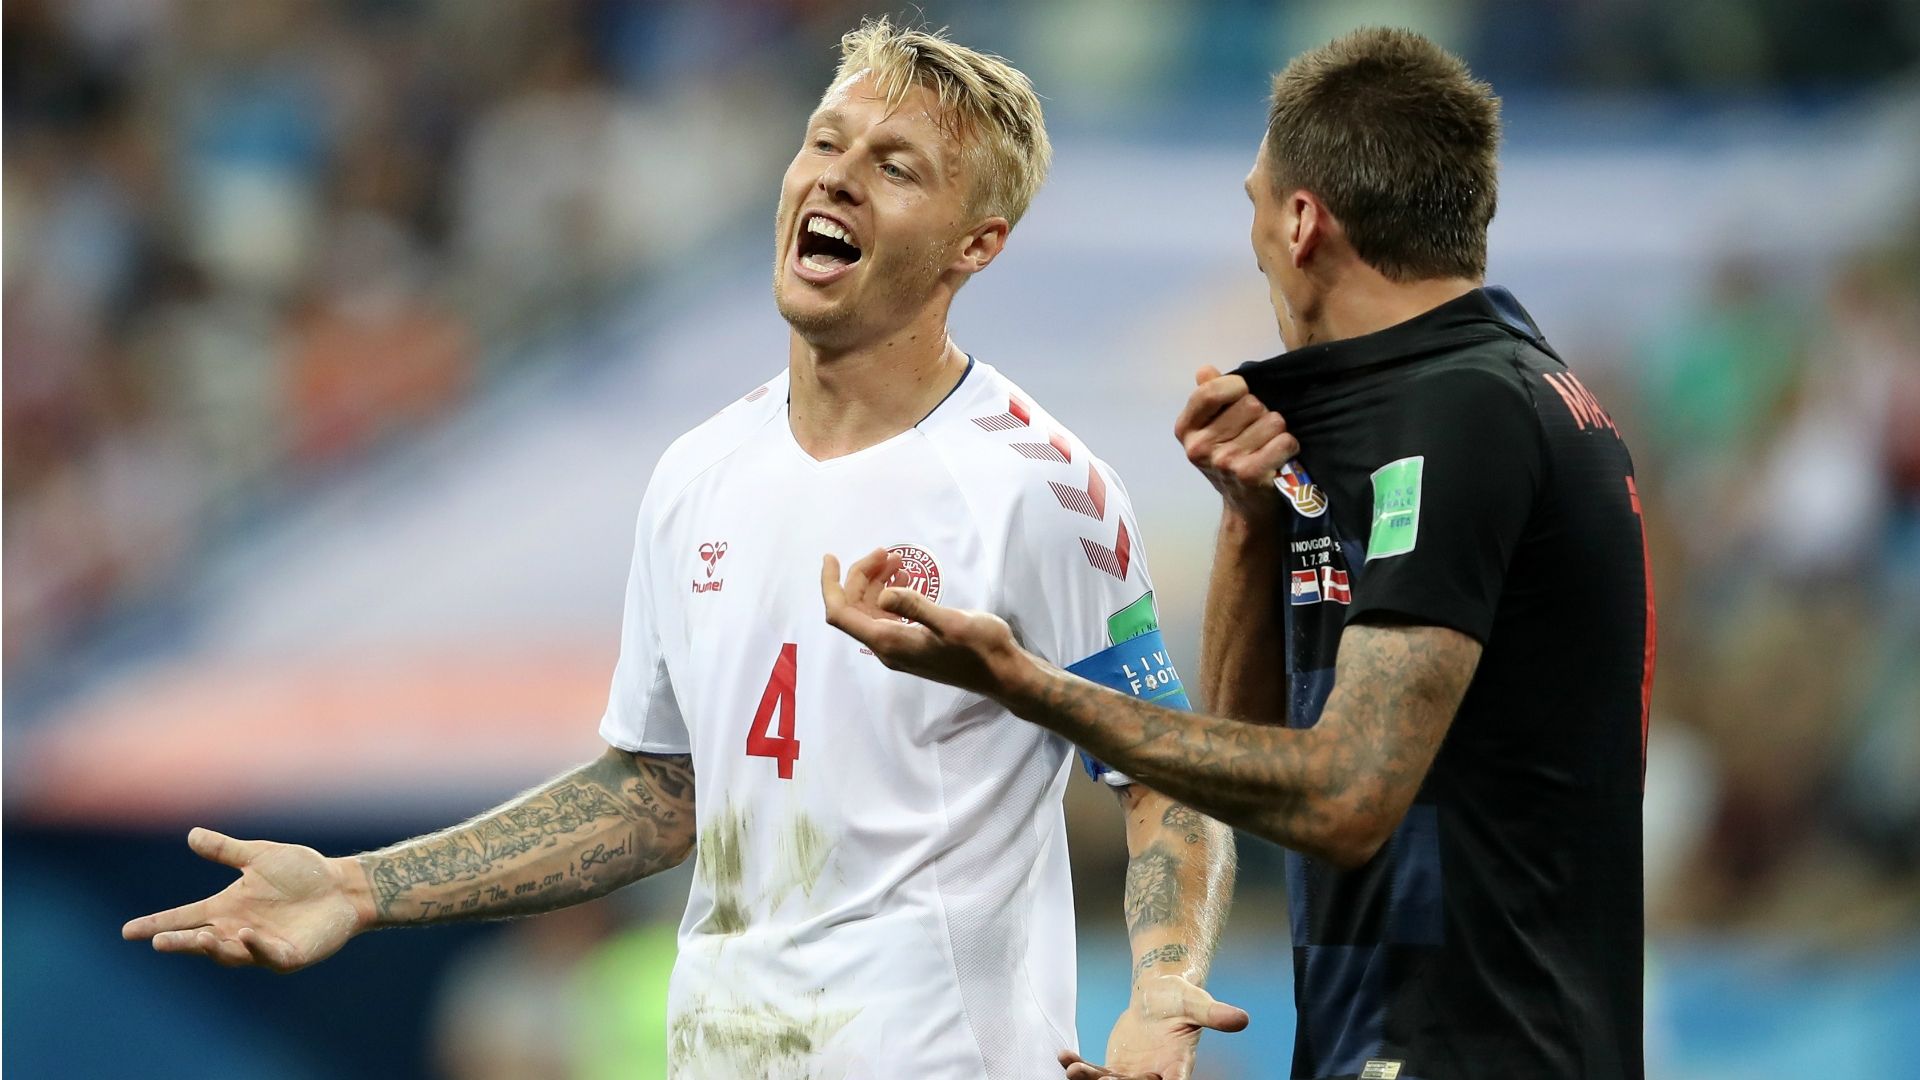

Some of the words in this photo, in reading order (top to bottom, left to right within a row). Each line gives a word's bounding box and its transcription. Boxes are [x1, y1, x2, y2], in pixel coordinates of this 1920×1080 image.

[1542, 371, 1620, 440] MA
[1122, 649, 1172, 679] LIV
[1130, 666, 1180, 695] FOOT
[746, 643, 800, 779] 4
